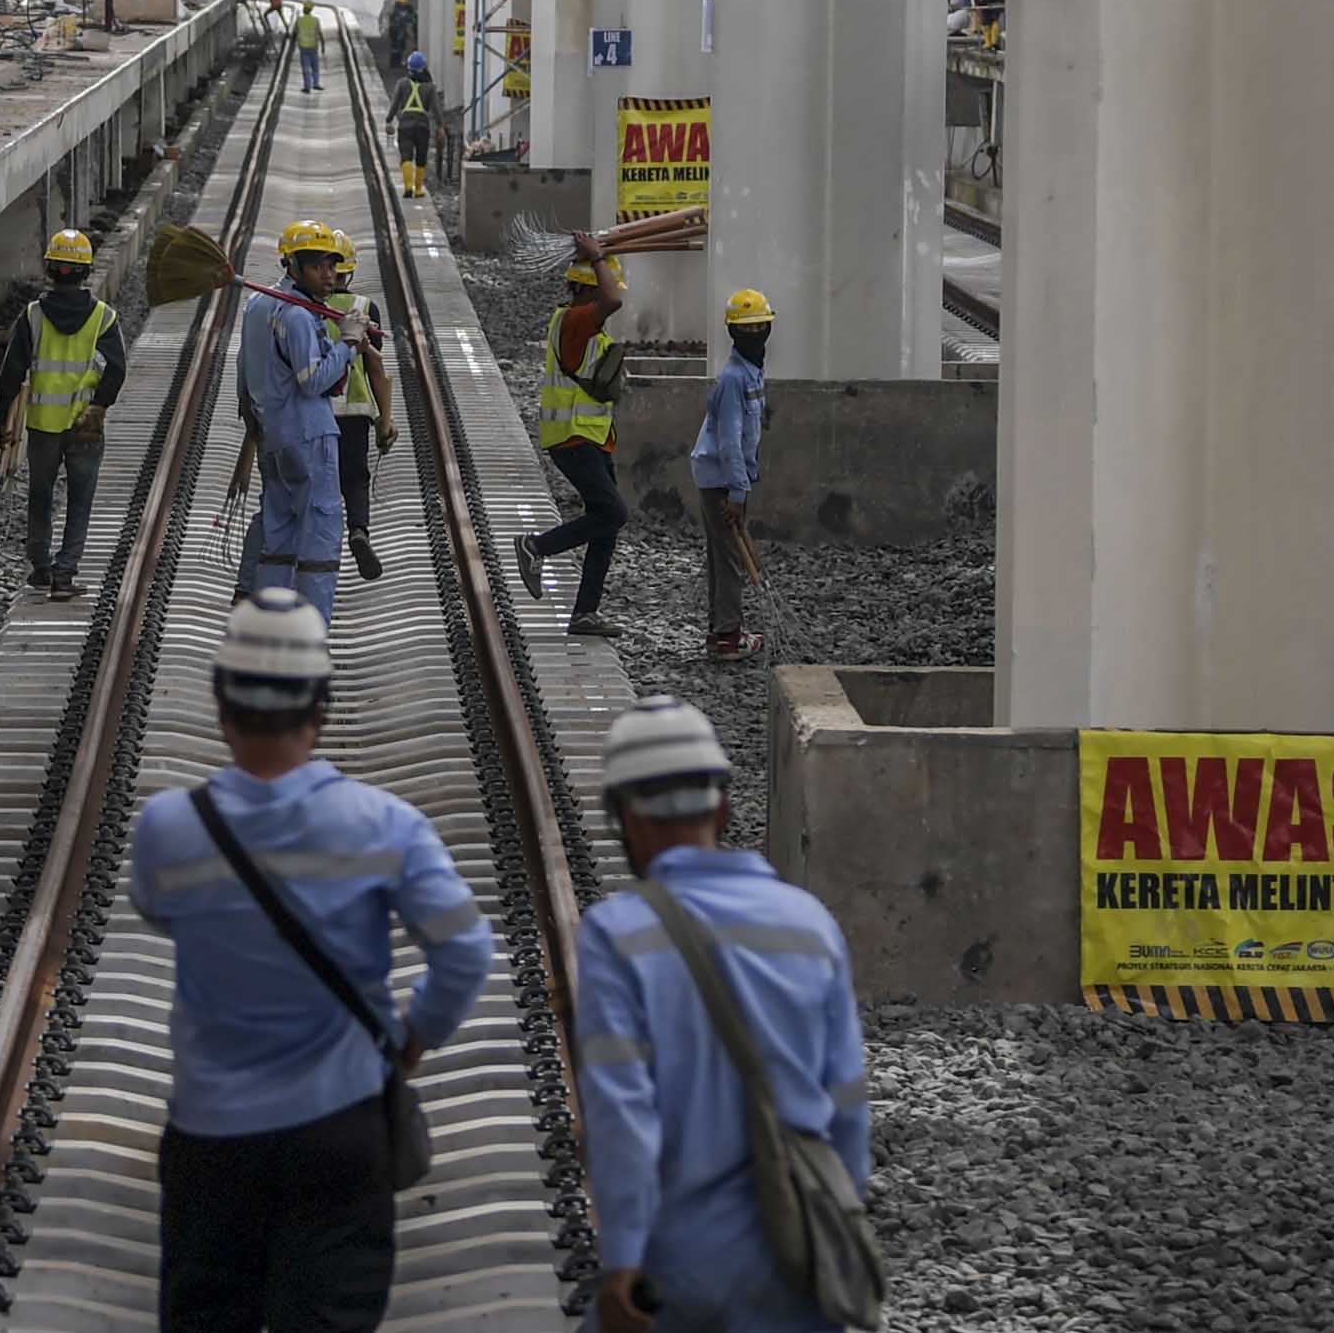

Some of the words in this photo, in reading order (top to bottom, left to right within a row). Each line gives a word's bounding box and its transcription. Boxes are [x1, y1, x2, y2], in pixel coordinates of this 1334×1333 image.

[603, 32, 621, 43] LINE
[606, 43, 618, 65] 4
[622, 122, 710, 163] AWA
[621, 167, 670, 182] KERETA
[673, 166, 710, 181] MELIN
[1096, 872, 1223, 911] KERETA
[1193, 962, 1233, 971] NASIONAL
[1236, 962, 1265, 971] KERETA
[1266, 963, 1291, 972] CEPAT
[1292, 963, 1327, 972] JAKARTA
